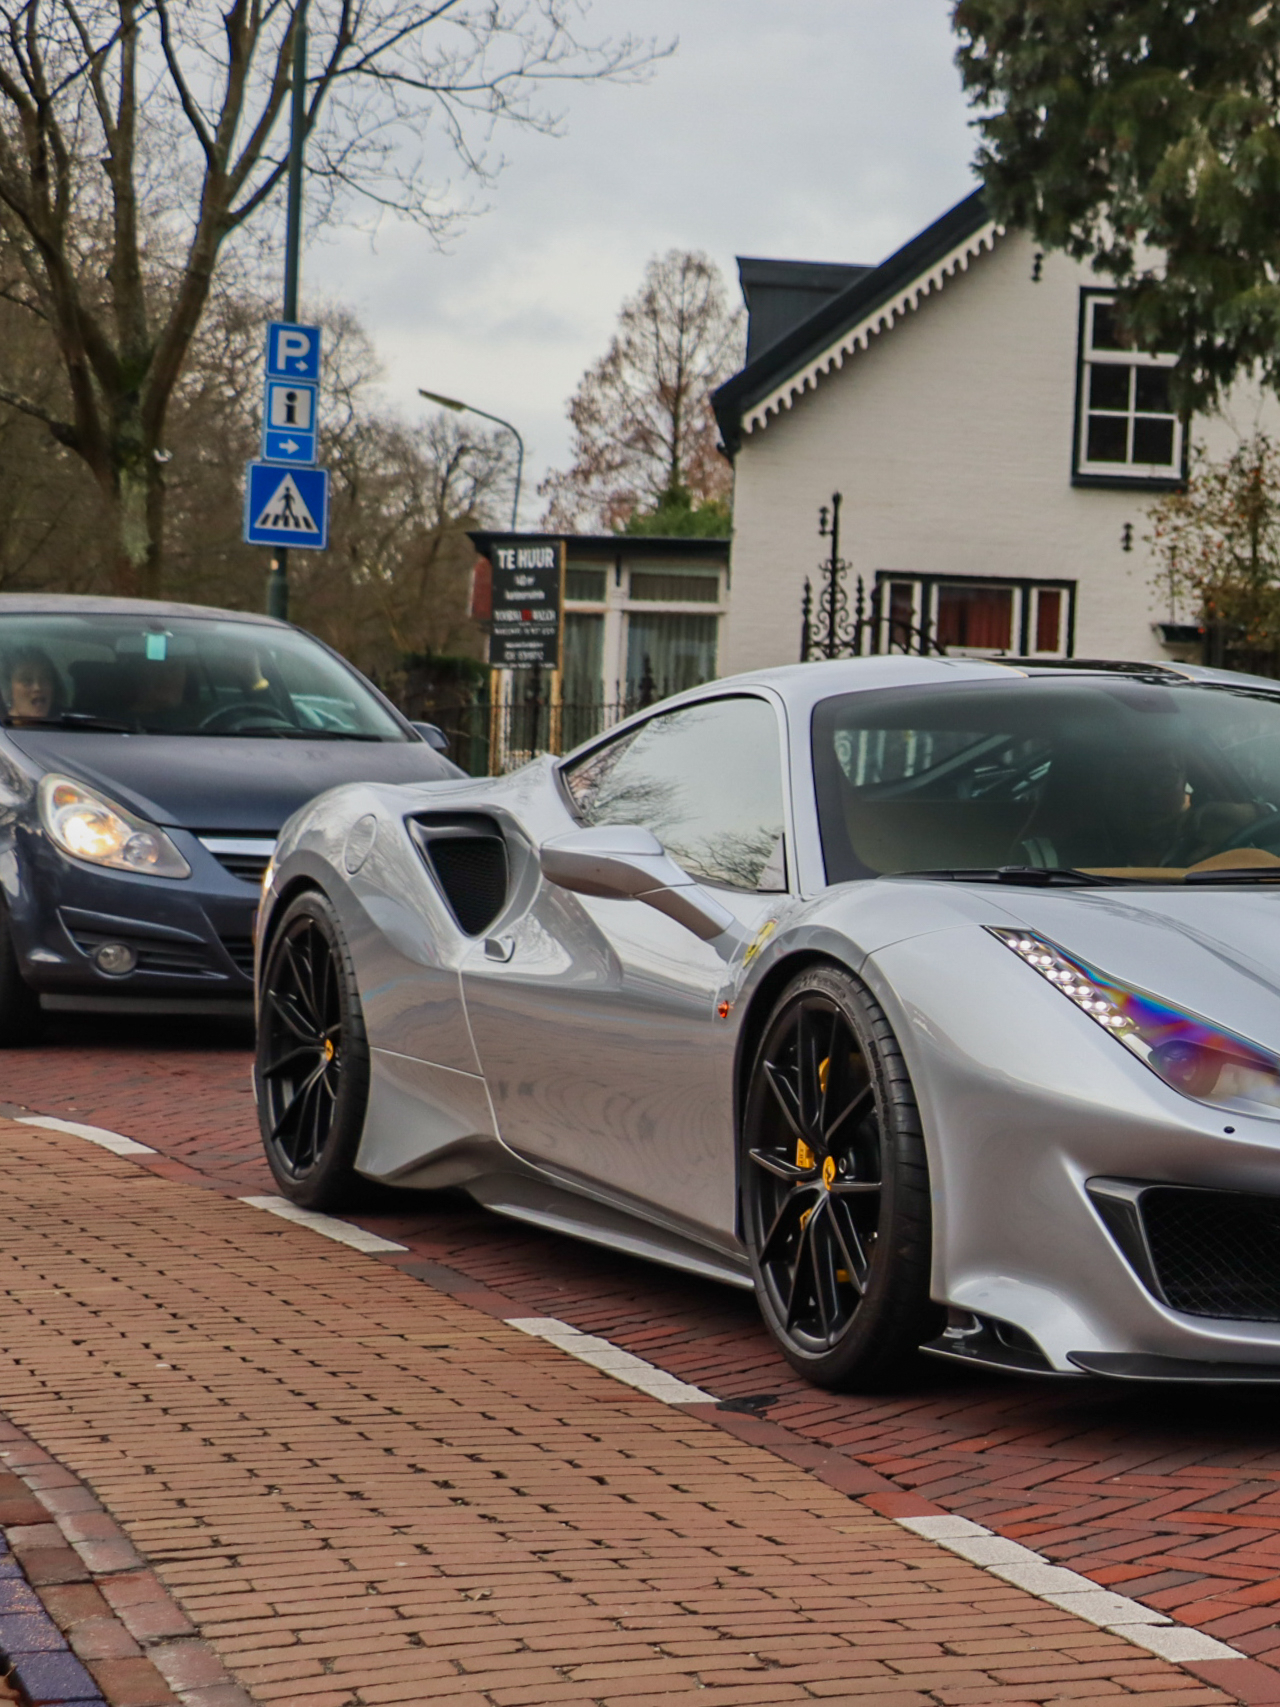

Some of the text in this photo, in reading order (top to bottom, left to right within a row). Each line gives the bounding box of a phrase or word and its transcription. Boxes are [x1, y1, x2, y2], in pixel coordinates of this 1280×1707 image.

[276, 329, 311, 370] P
[497, 547, 555, 570] TE HUUR
